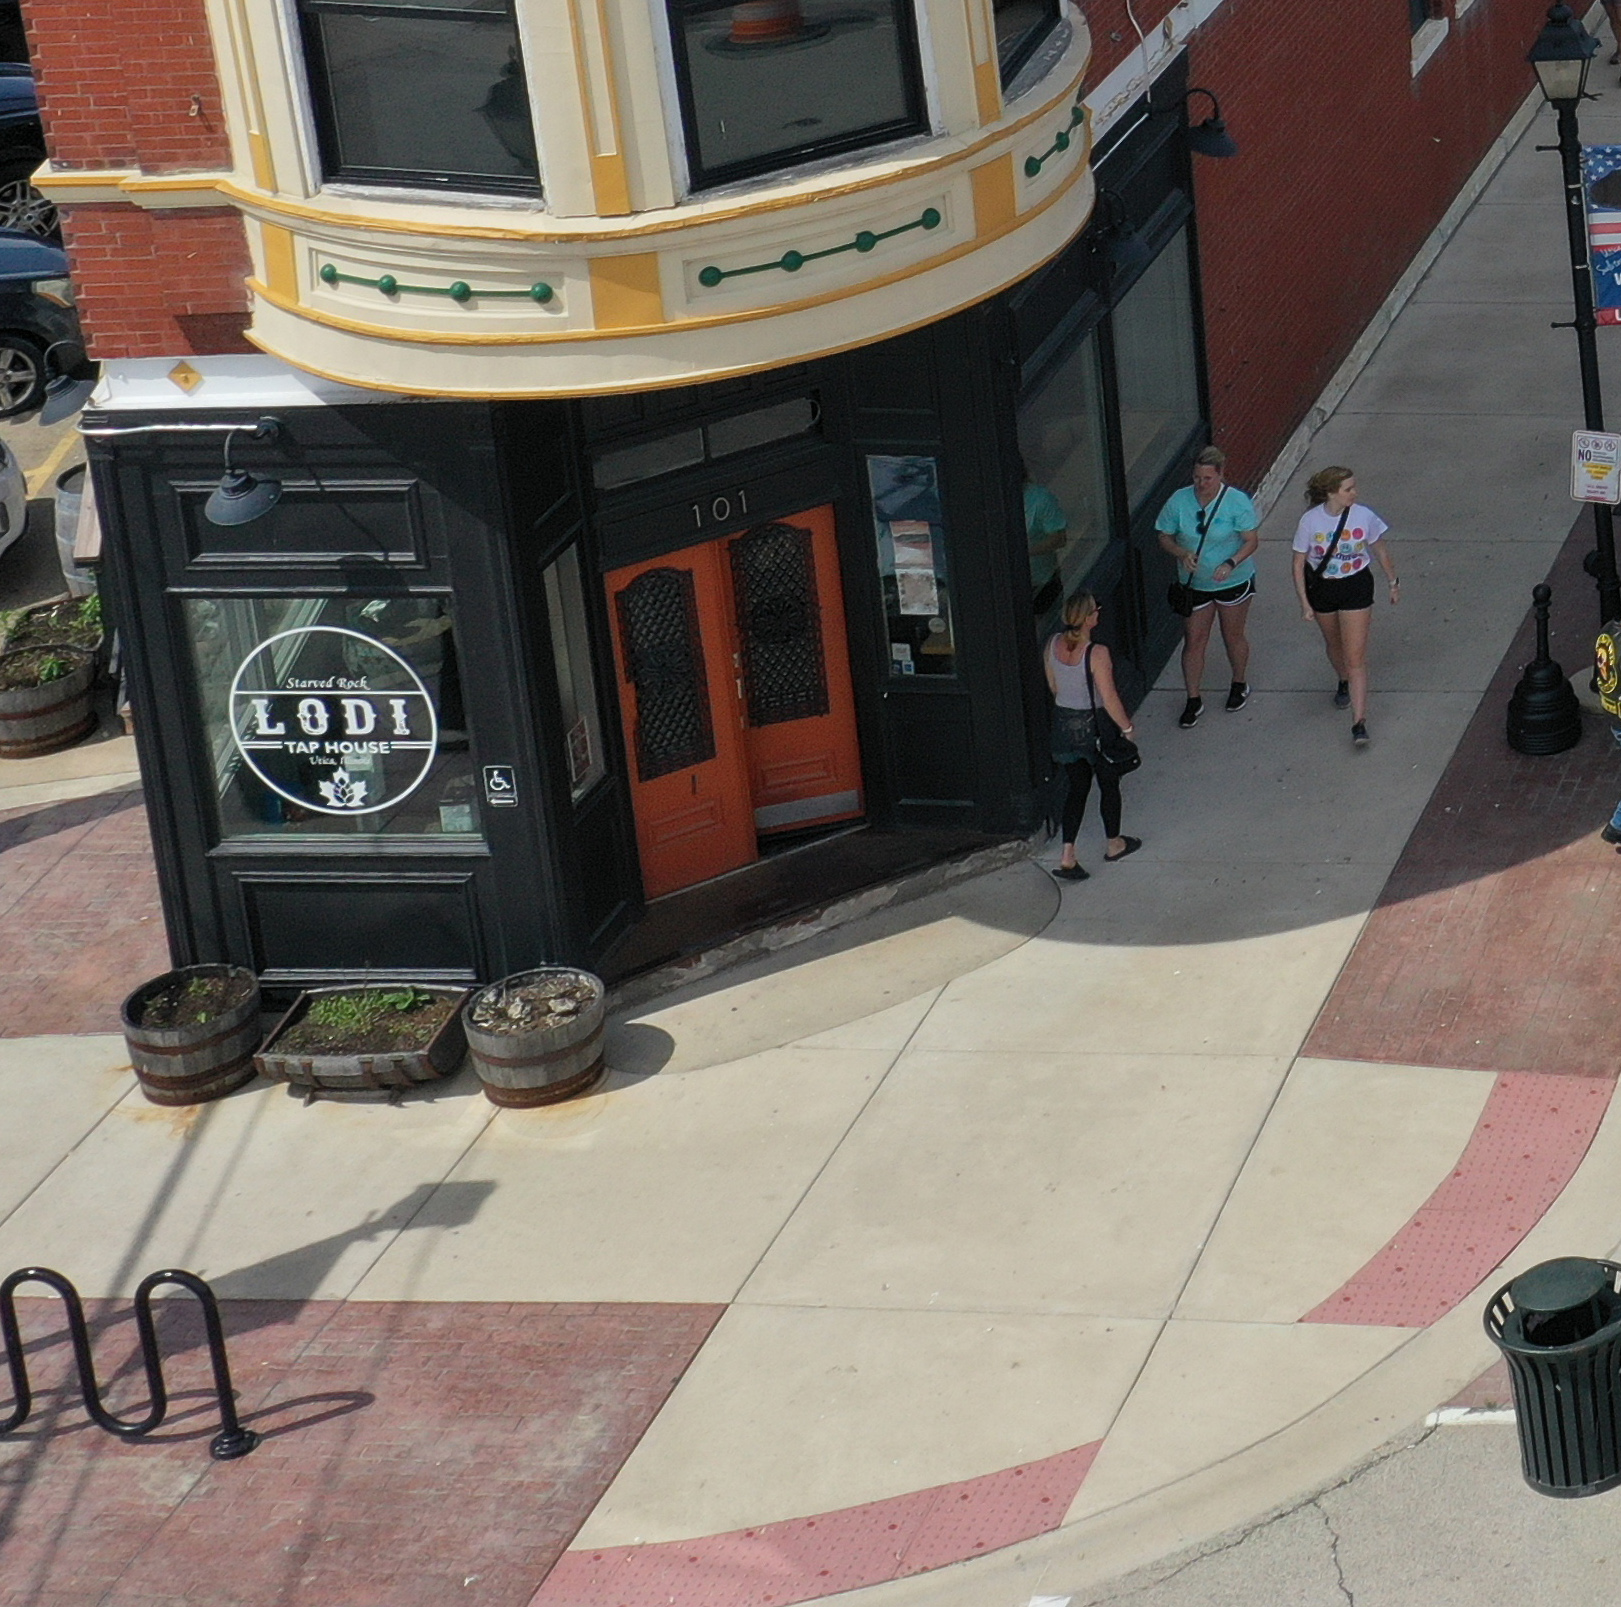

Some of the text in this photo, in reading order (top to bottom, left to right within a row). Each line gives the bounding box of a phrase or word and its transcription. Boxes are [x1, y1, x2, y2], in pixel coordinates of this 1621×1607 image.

[1577, 448, 1592, 462] NO
[692, 489, 748, 528] 101
[286, 675, 372, 691] Starved Rock
[251, 697, 411, 736] LODI
[284, 741, 391, 755] TAP HOUSE
